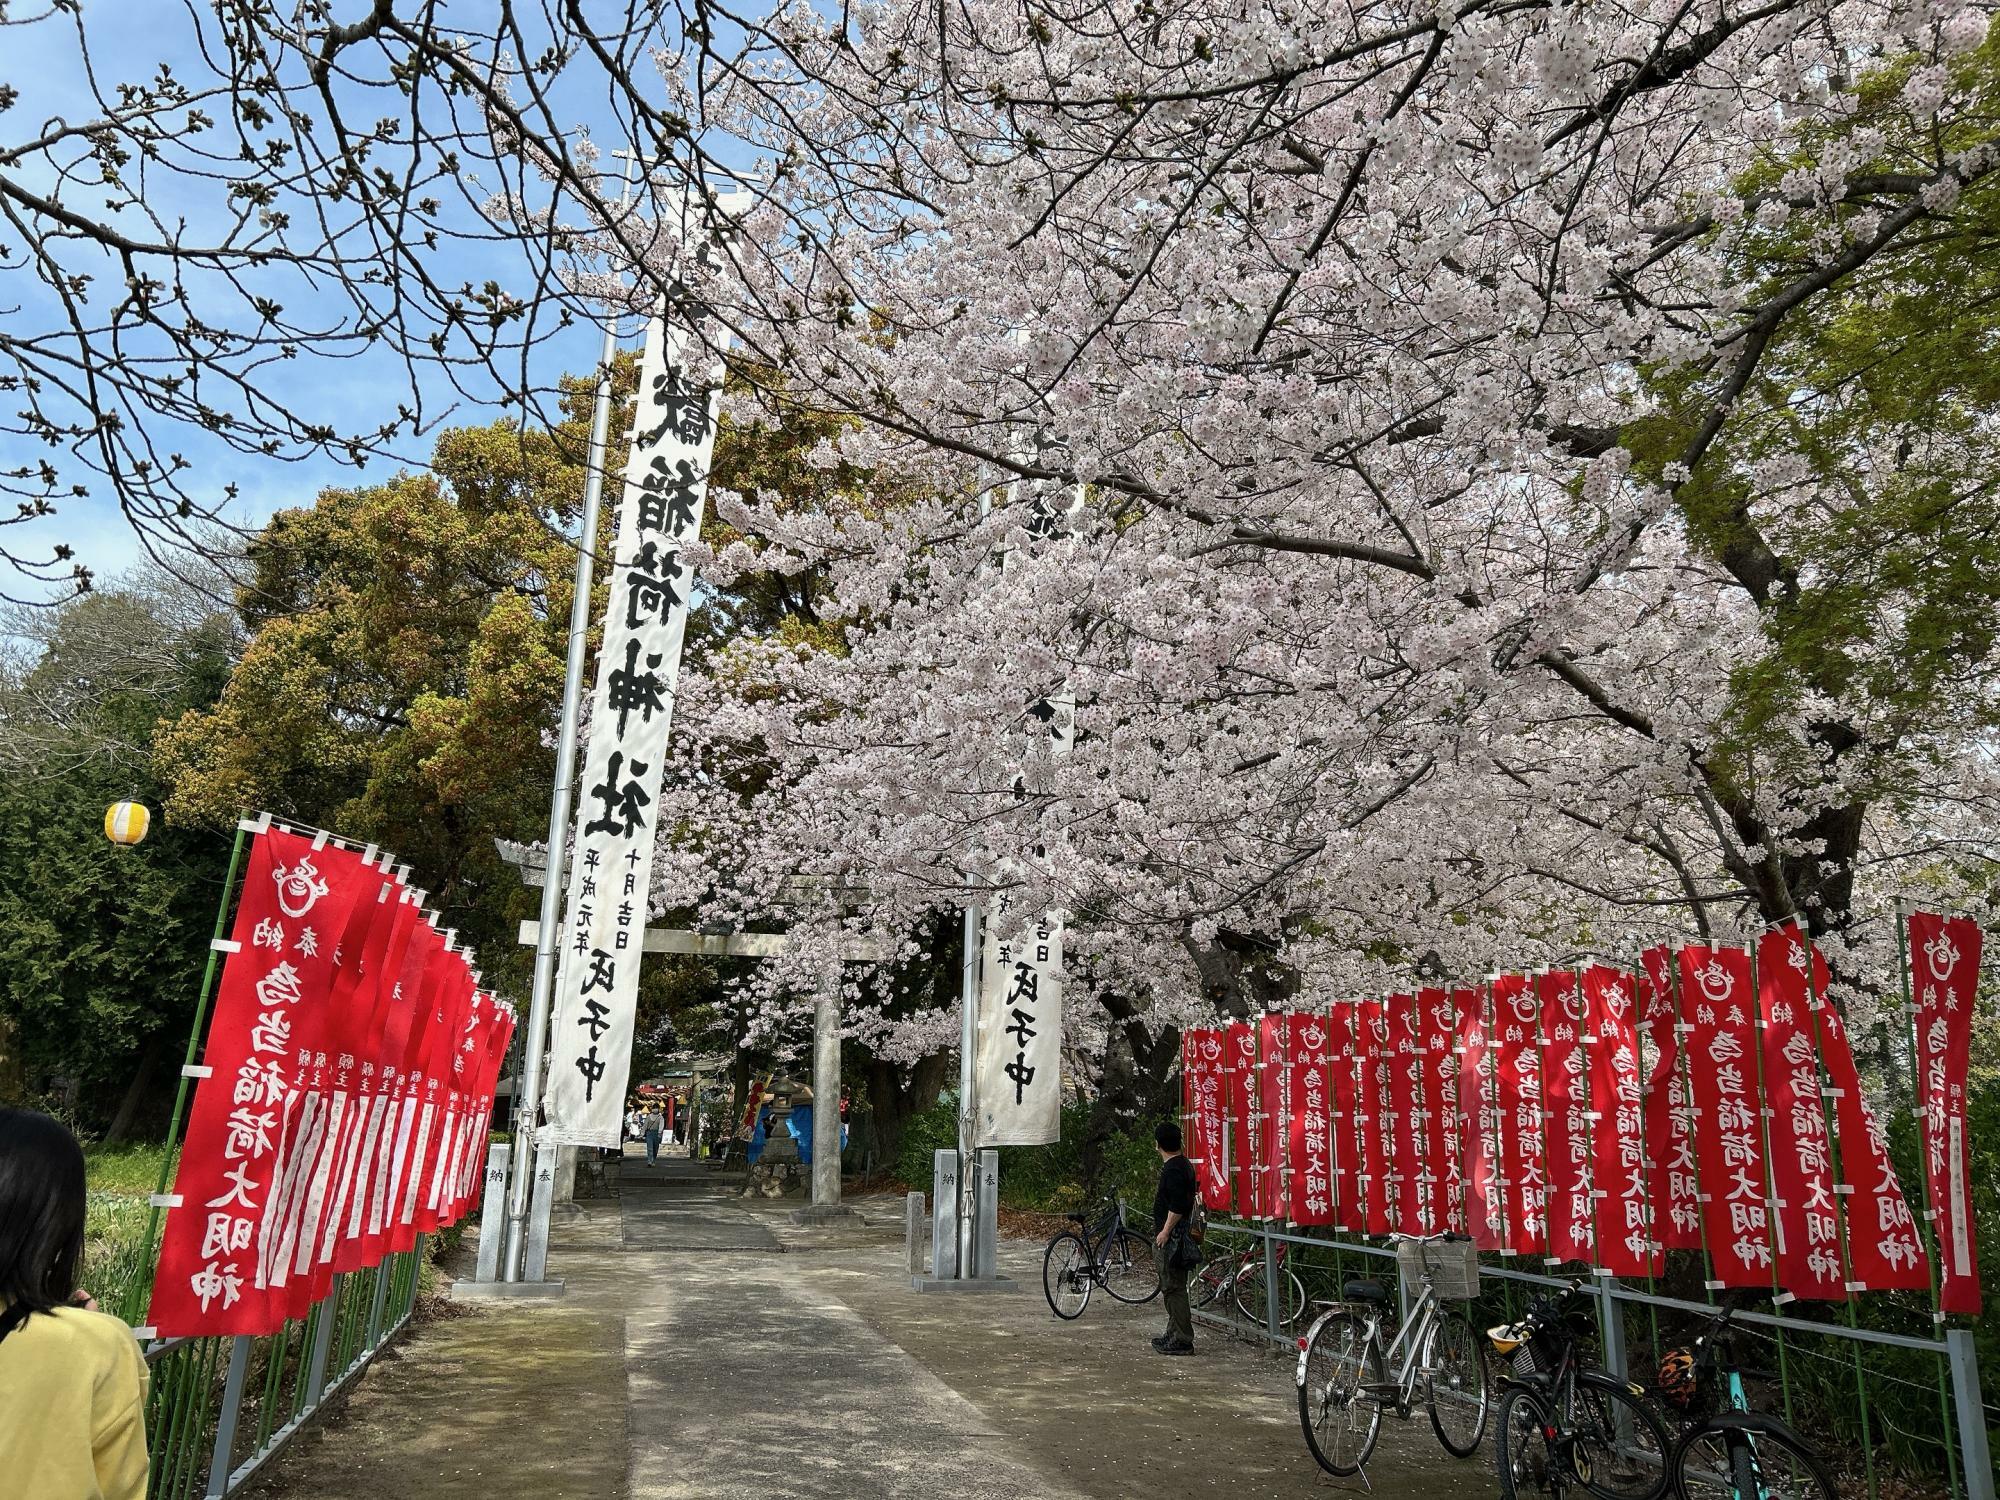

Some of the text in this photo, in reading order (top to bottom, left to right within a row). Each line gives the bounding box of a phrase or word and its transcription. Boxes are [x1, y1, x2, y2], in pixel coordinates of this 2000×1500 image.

[488, 1169, 504, 1183] 納
[538, 1169, 551, 1182] 奉
[942, 1173, 955, 1186] 納
[985, 1173, 996, 1186] 奉
